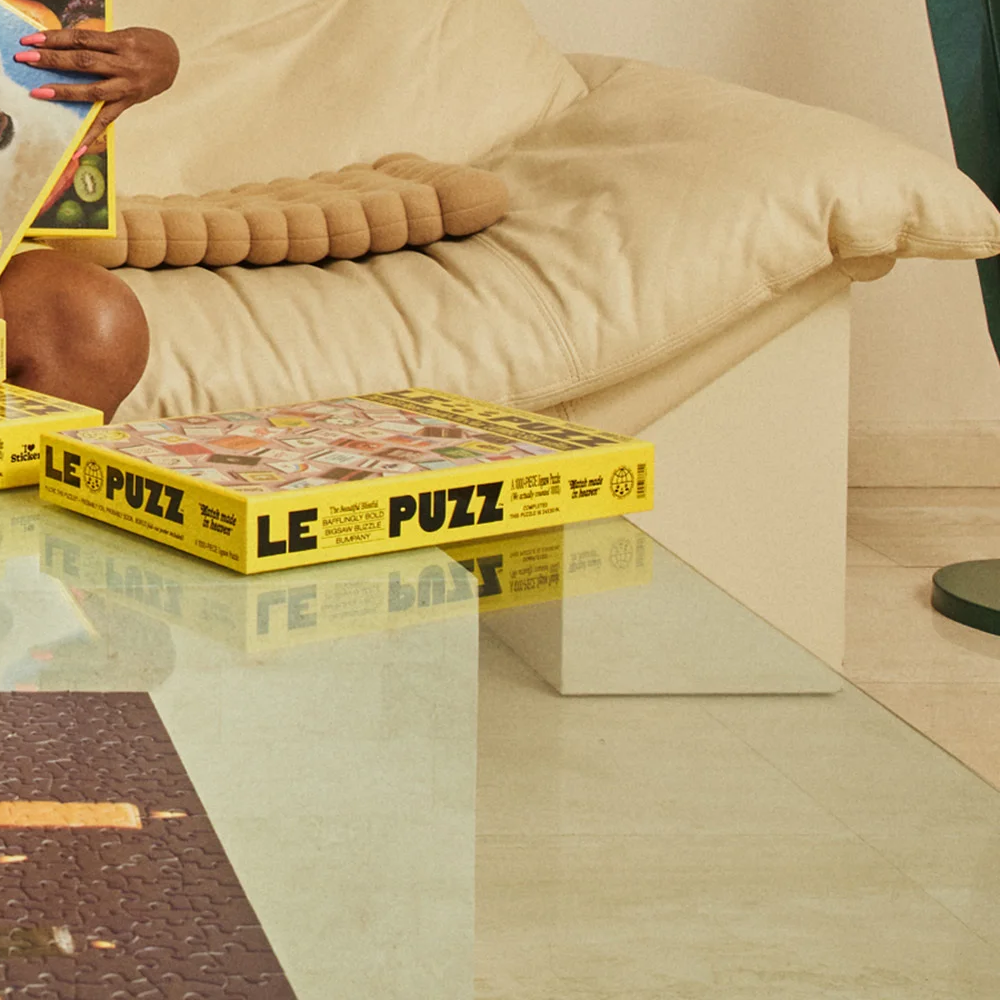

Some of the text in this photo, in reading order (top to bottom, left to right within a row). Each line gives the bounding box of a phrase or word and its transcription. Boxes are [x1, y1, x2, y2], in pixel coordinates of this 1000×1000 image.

[11, 452, 40, 463] Sticker
[45, 445, 185, 525] LE PUZZ
[258, 481, 504, 558] LE PUZZ
[322, 511, 384, 526] BAFFLINGLY BOLD
[325, 521, 381, 536] BIGSAW BUZZLE
[336, 533, 371, 544] BUMPANY
